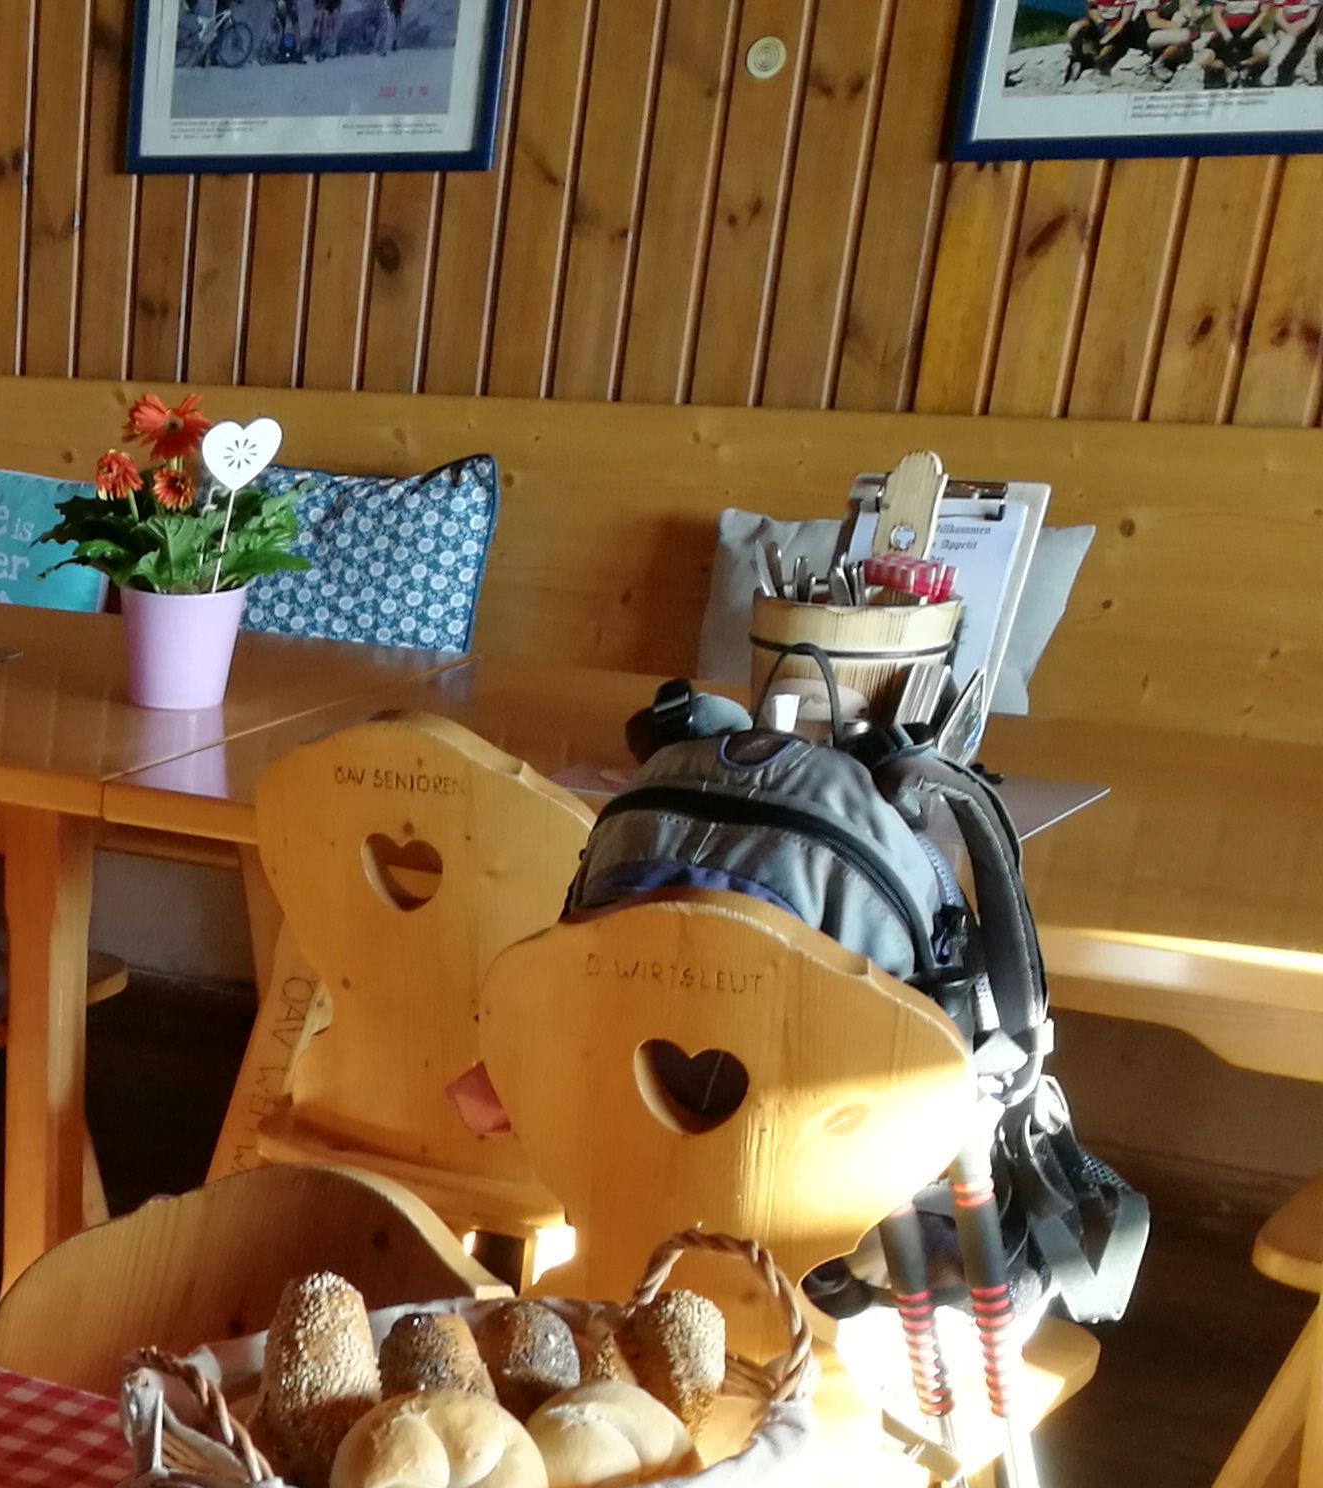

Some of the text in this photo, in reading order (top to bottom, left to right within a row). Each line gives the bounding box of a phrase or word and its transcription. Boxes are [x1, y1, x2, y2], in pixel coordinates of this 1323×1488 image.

[11, 517, 35, 542] is
[373, 768, 466, 796] SENIOREN
[614, 959, 763, 994] WIRTSLEUT
